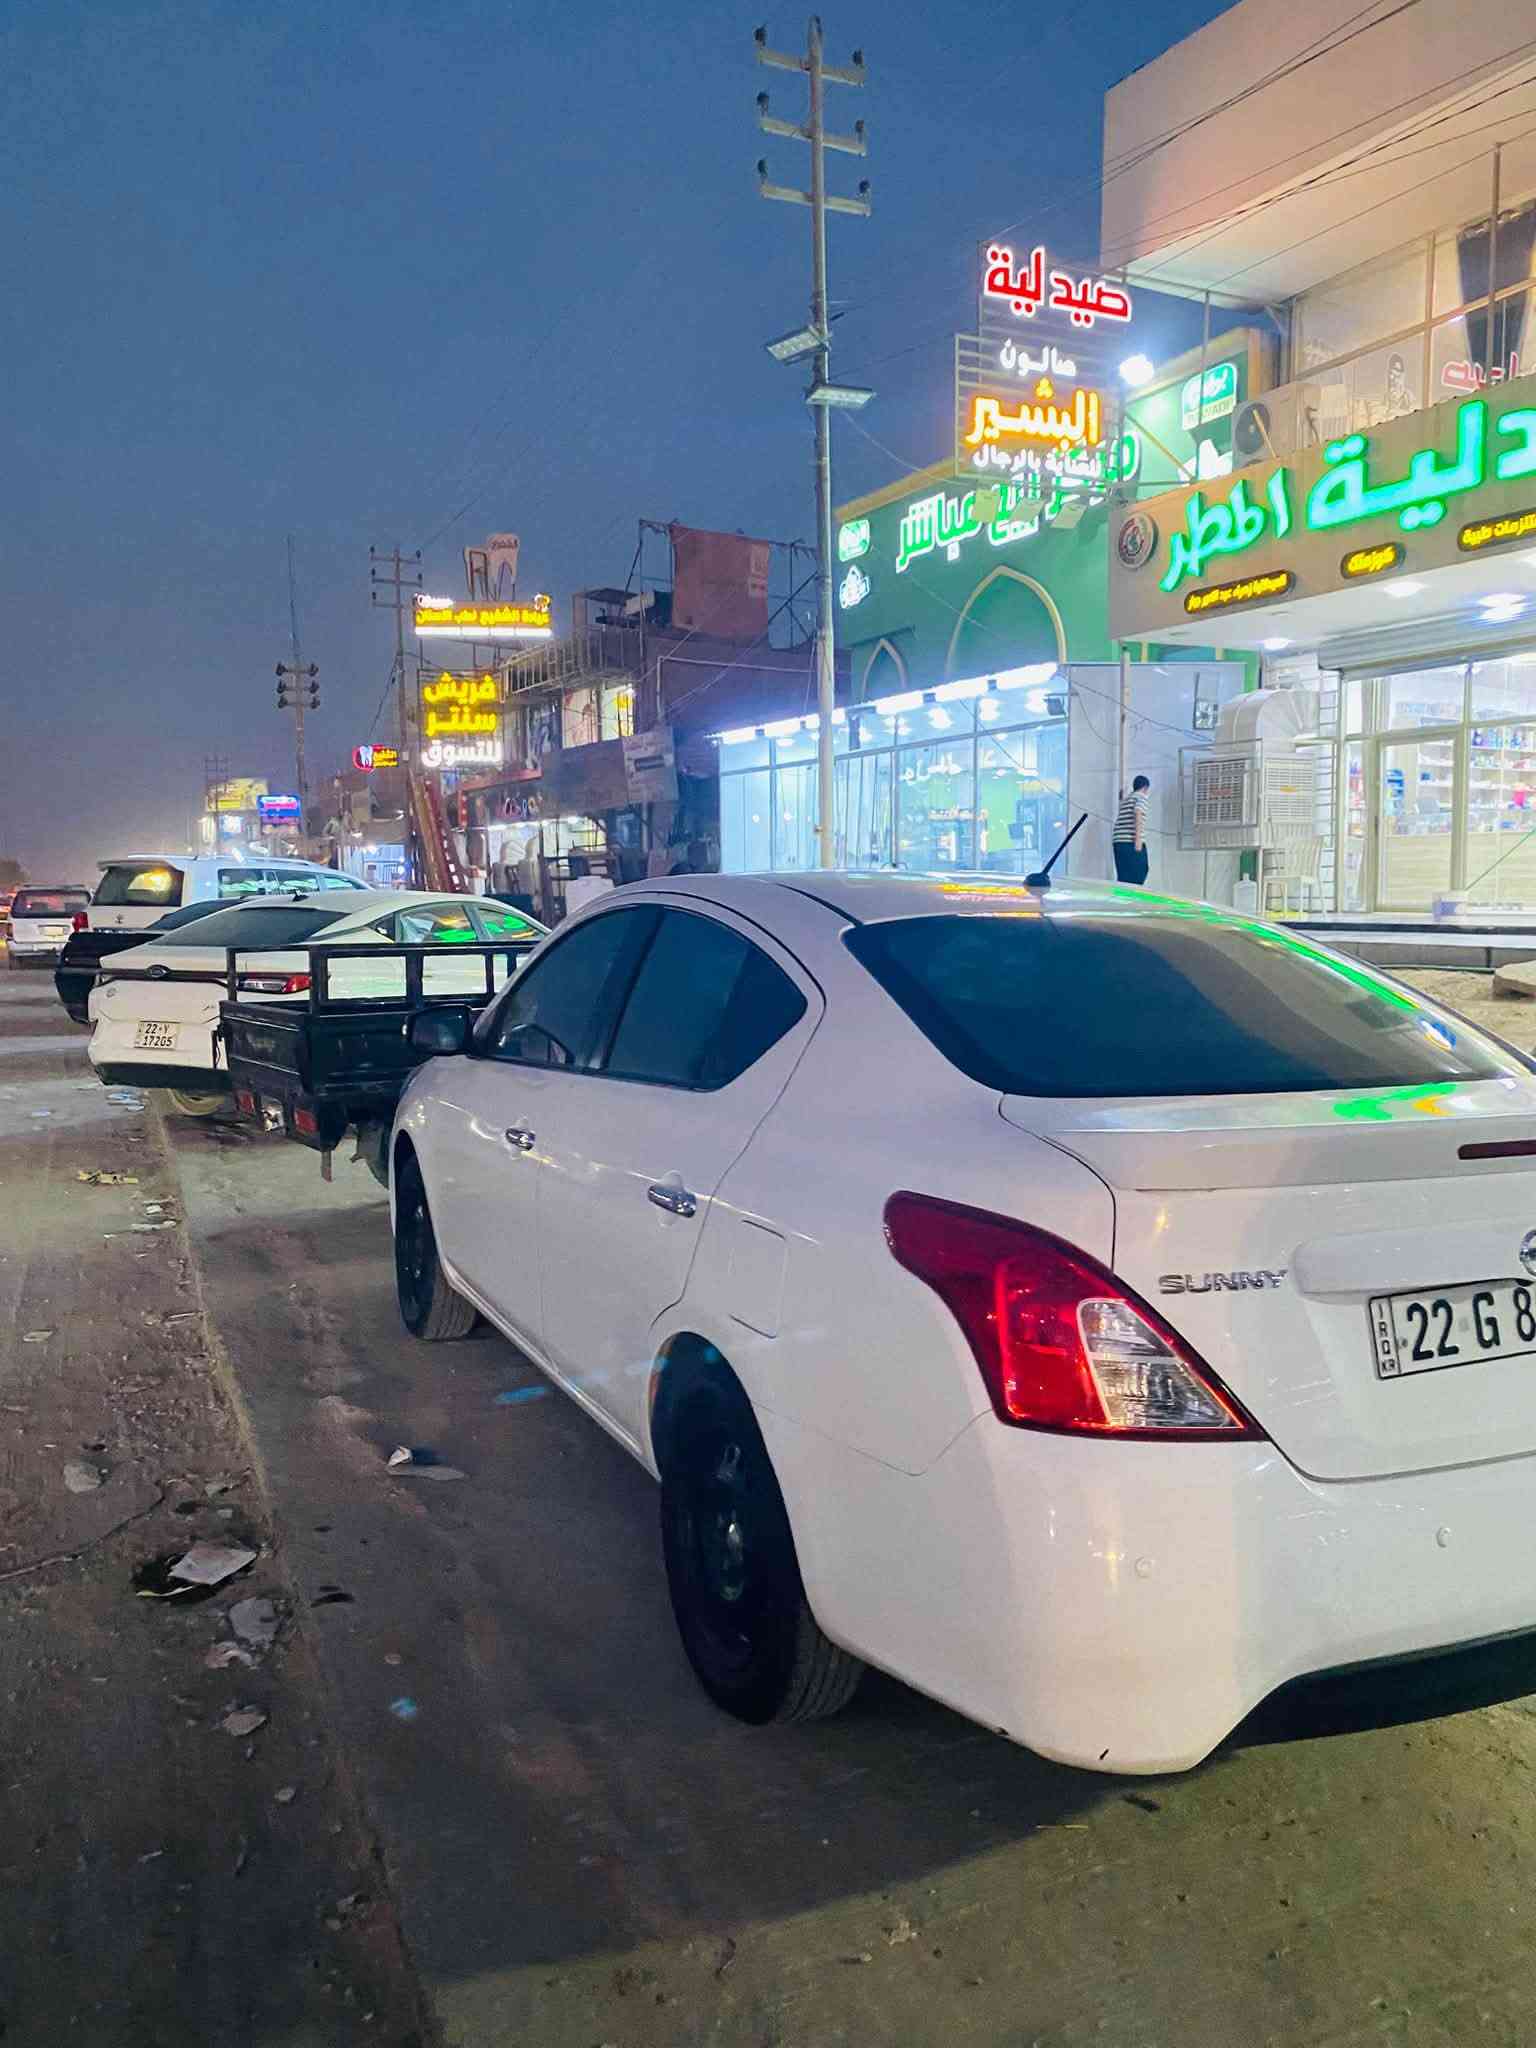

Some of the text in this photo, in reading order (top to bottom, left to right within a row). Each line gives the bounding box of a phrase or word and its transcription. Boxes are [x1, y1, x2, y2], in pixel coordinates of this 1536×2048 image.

[984, 246, 1132, 327] صيدلية
[1000, 338, 1076, 376] صالون
[965, 378, 1099, 451] البشير
[424, 672, 496, 704] فريش
[426, 705, 497, 737] سنتر
[1159, 1269, 1289, 1294] SUNNY
[1406, 1299, 1460, 1361] 22
[1472, 1291, 1501, 1348] G
